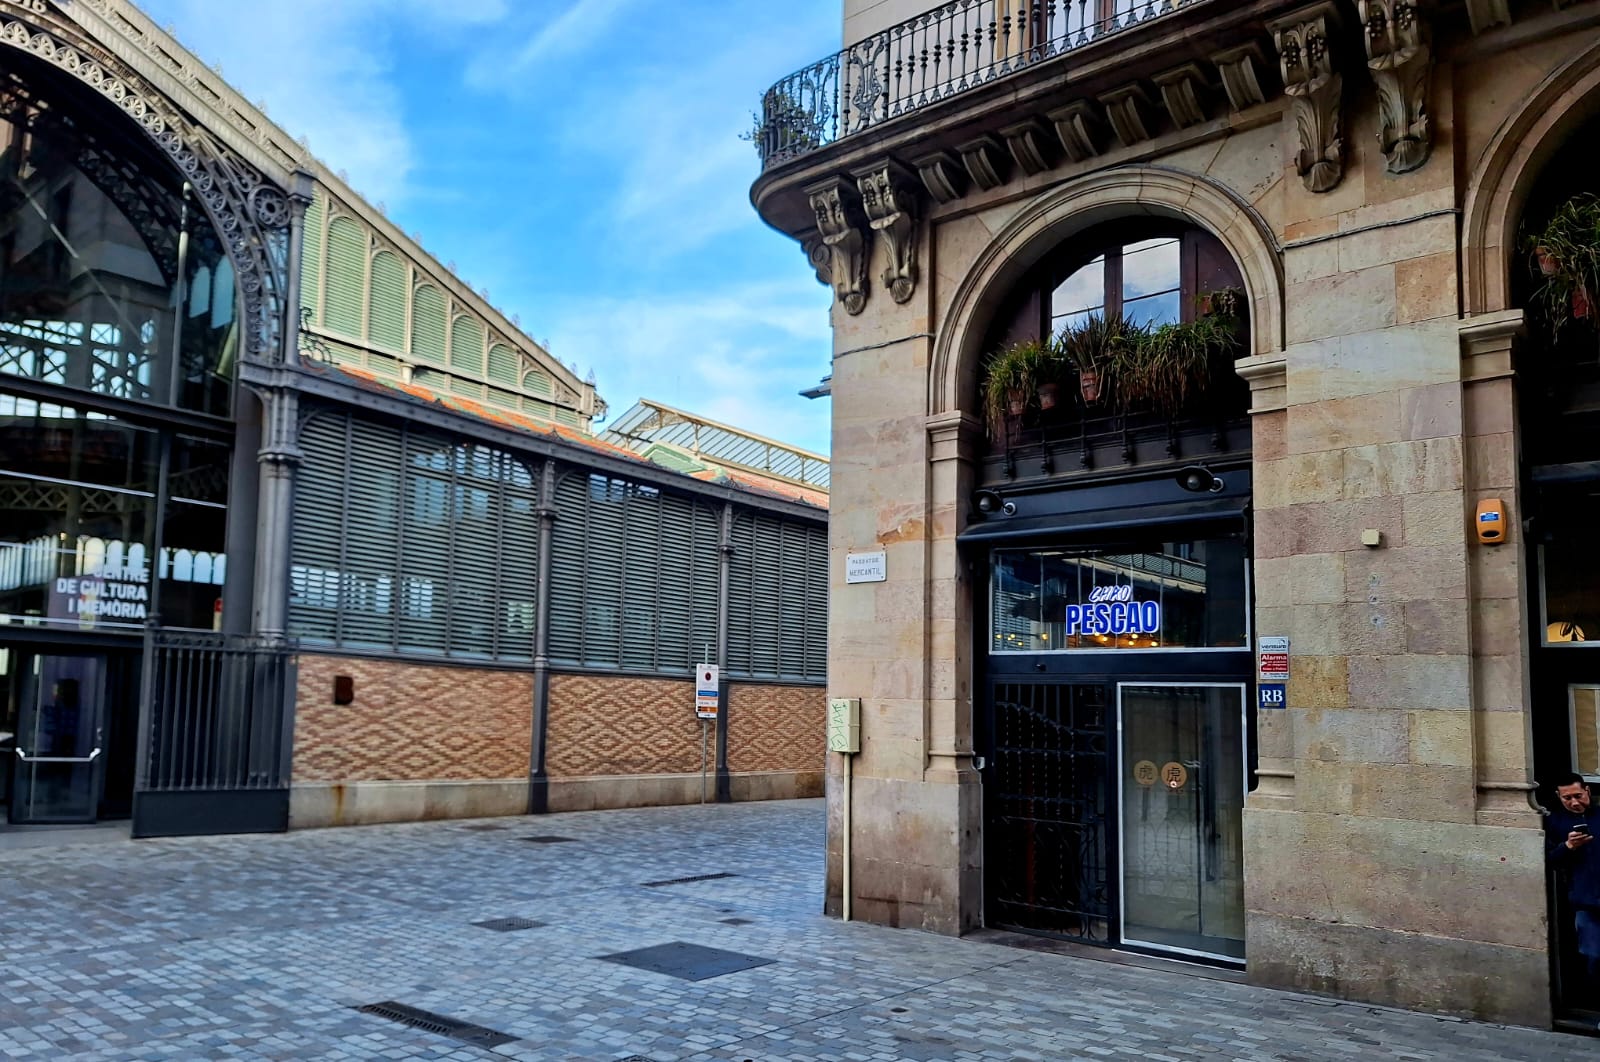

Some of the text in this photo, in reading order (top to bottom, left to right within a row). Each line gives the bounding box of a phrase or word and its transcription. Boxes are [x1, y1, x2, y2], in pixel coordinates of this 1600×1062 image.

[849, 567, 881, 577] MERCANTIL
[56, 577, 148, 601] DE CULTURA
[67, 597, 147, 619] I MEMÒRIA
[1065, 600, 1160, 636] PESCAO
[1261, 689, 1283, 703] RB
